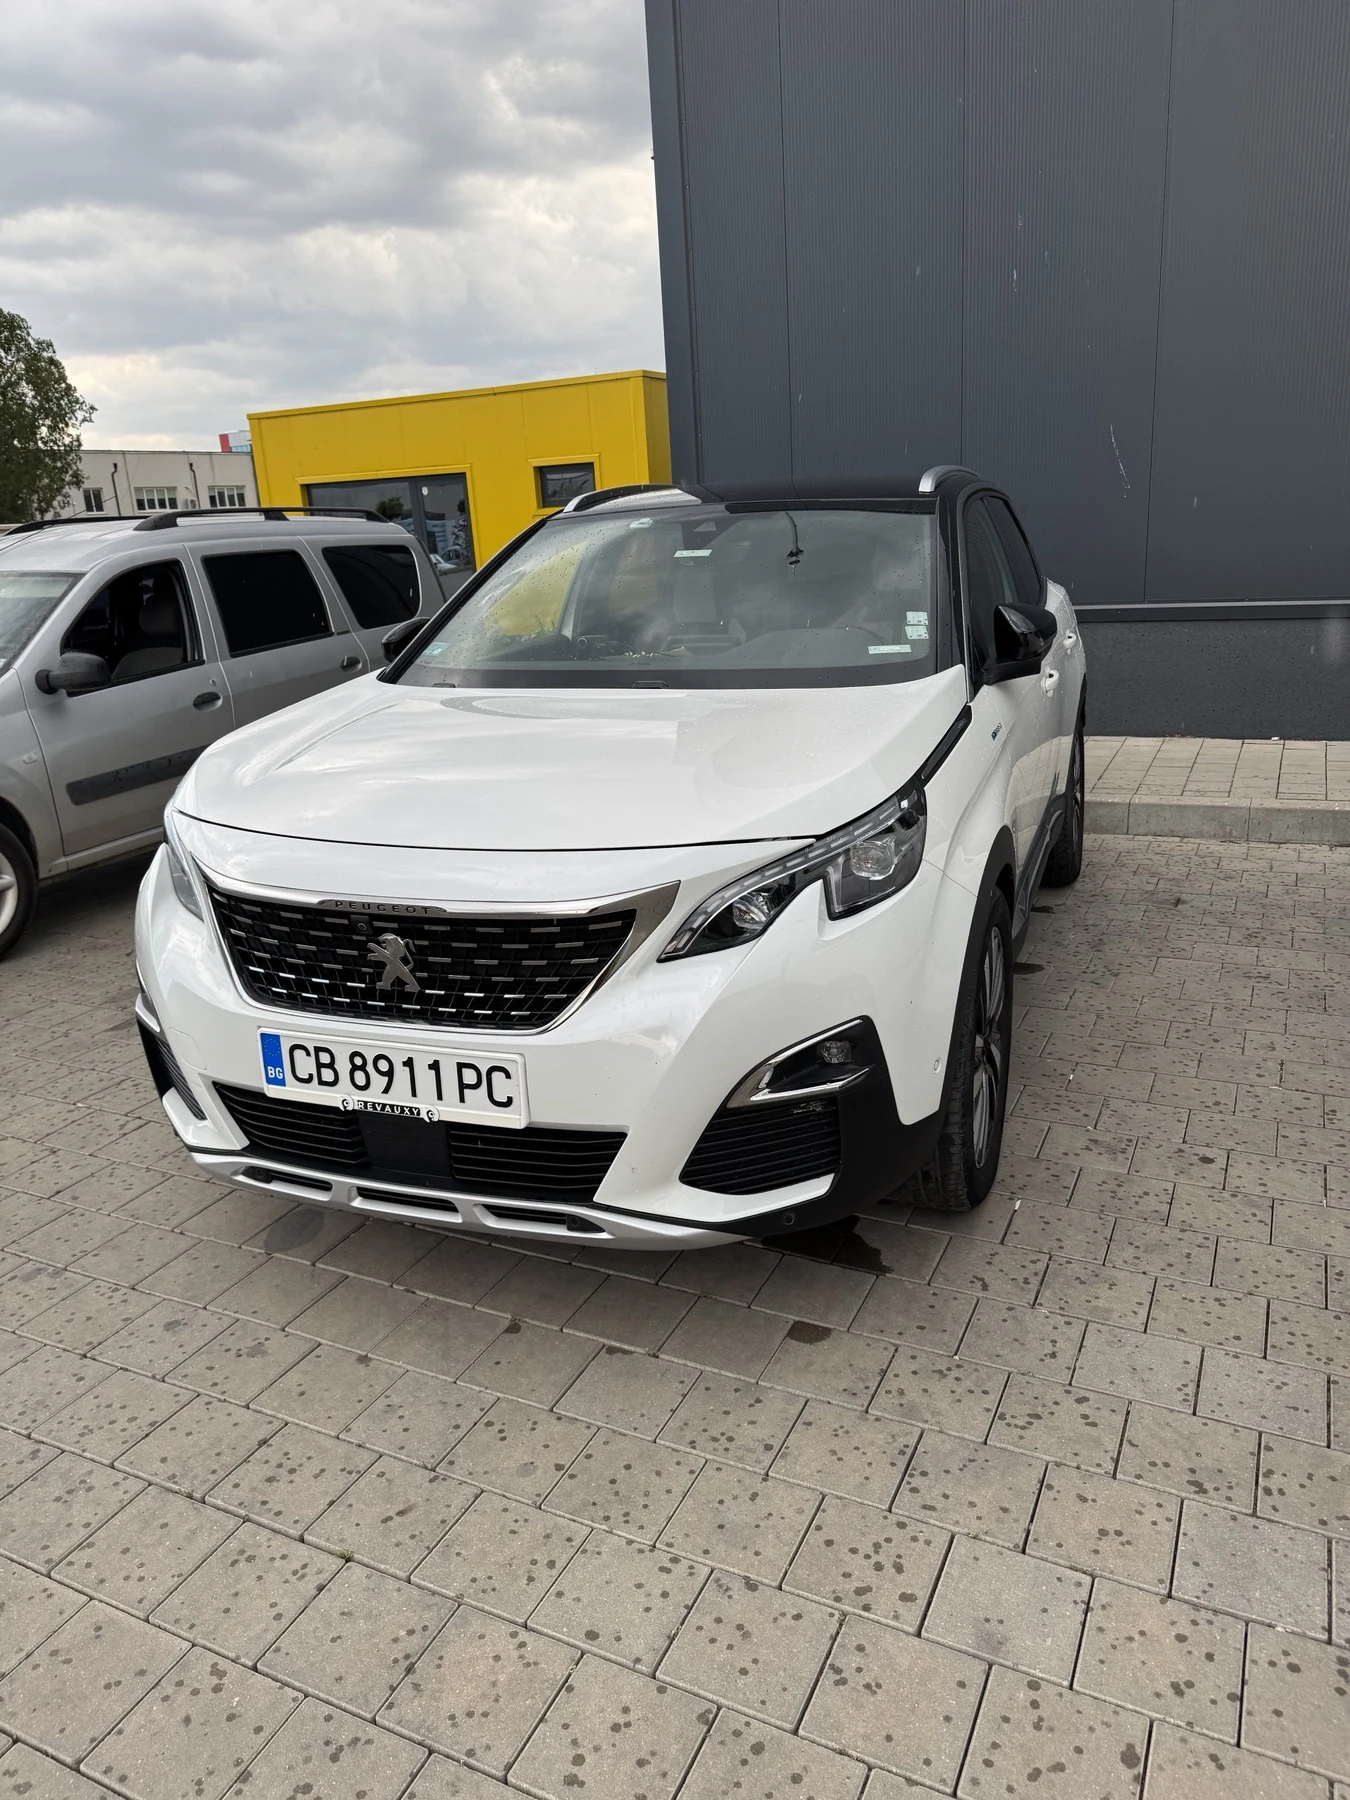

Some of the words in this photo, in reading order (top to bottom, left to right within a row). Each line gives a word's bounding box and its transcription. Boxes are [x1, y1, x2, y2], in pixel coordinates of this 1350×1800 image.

[335, 901, 431, 914] PEUGEOT
[267, 1066, 284, 1080] BG
[348, 1050, 443, 1102] 8911
[358, 1101, 419, 1116] REVAUXY
